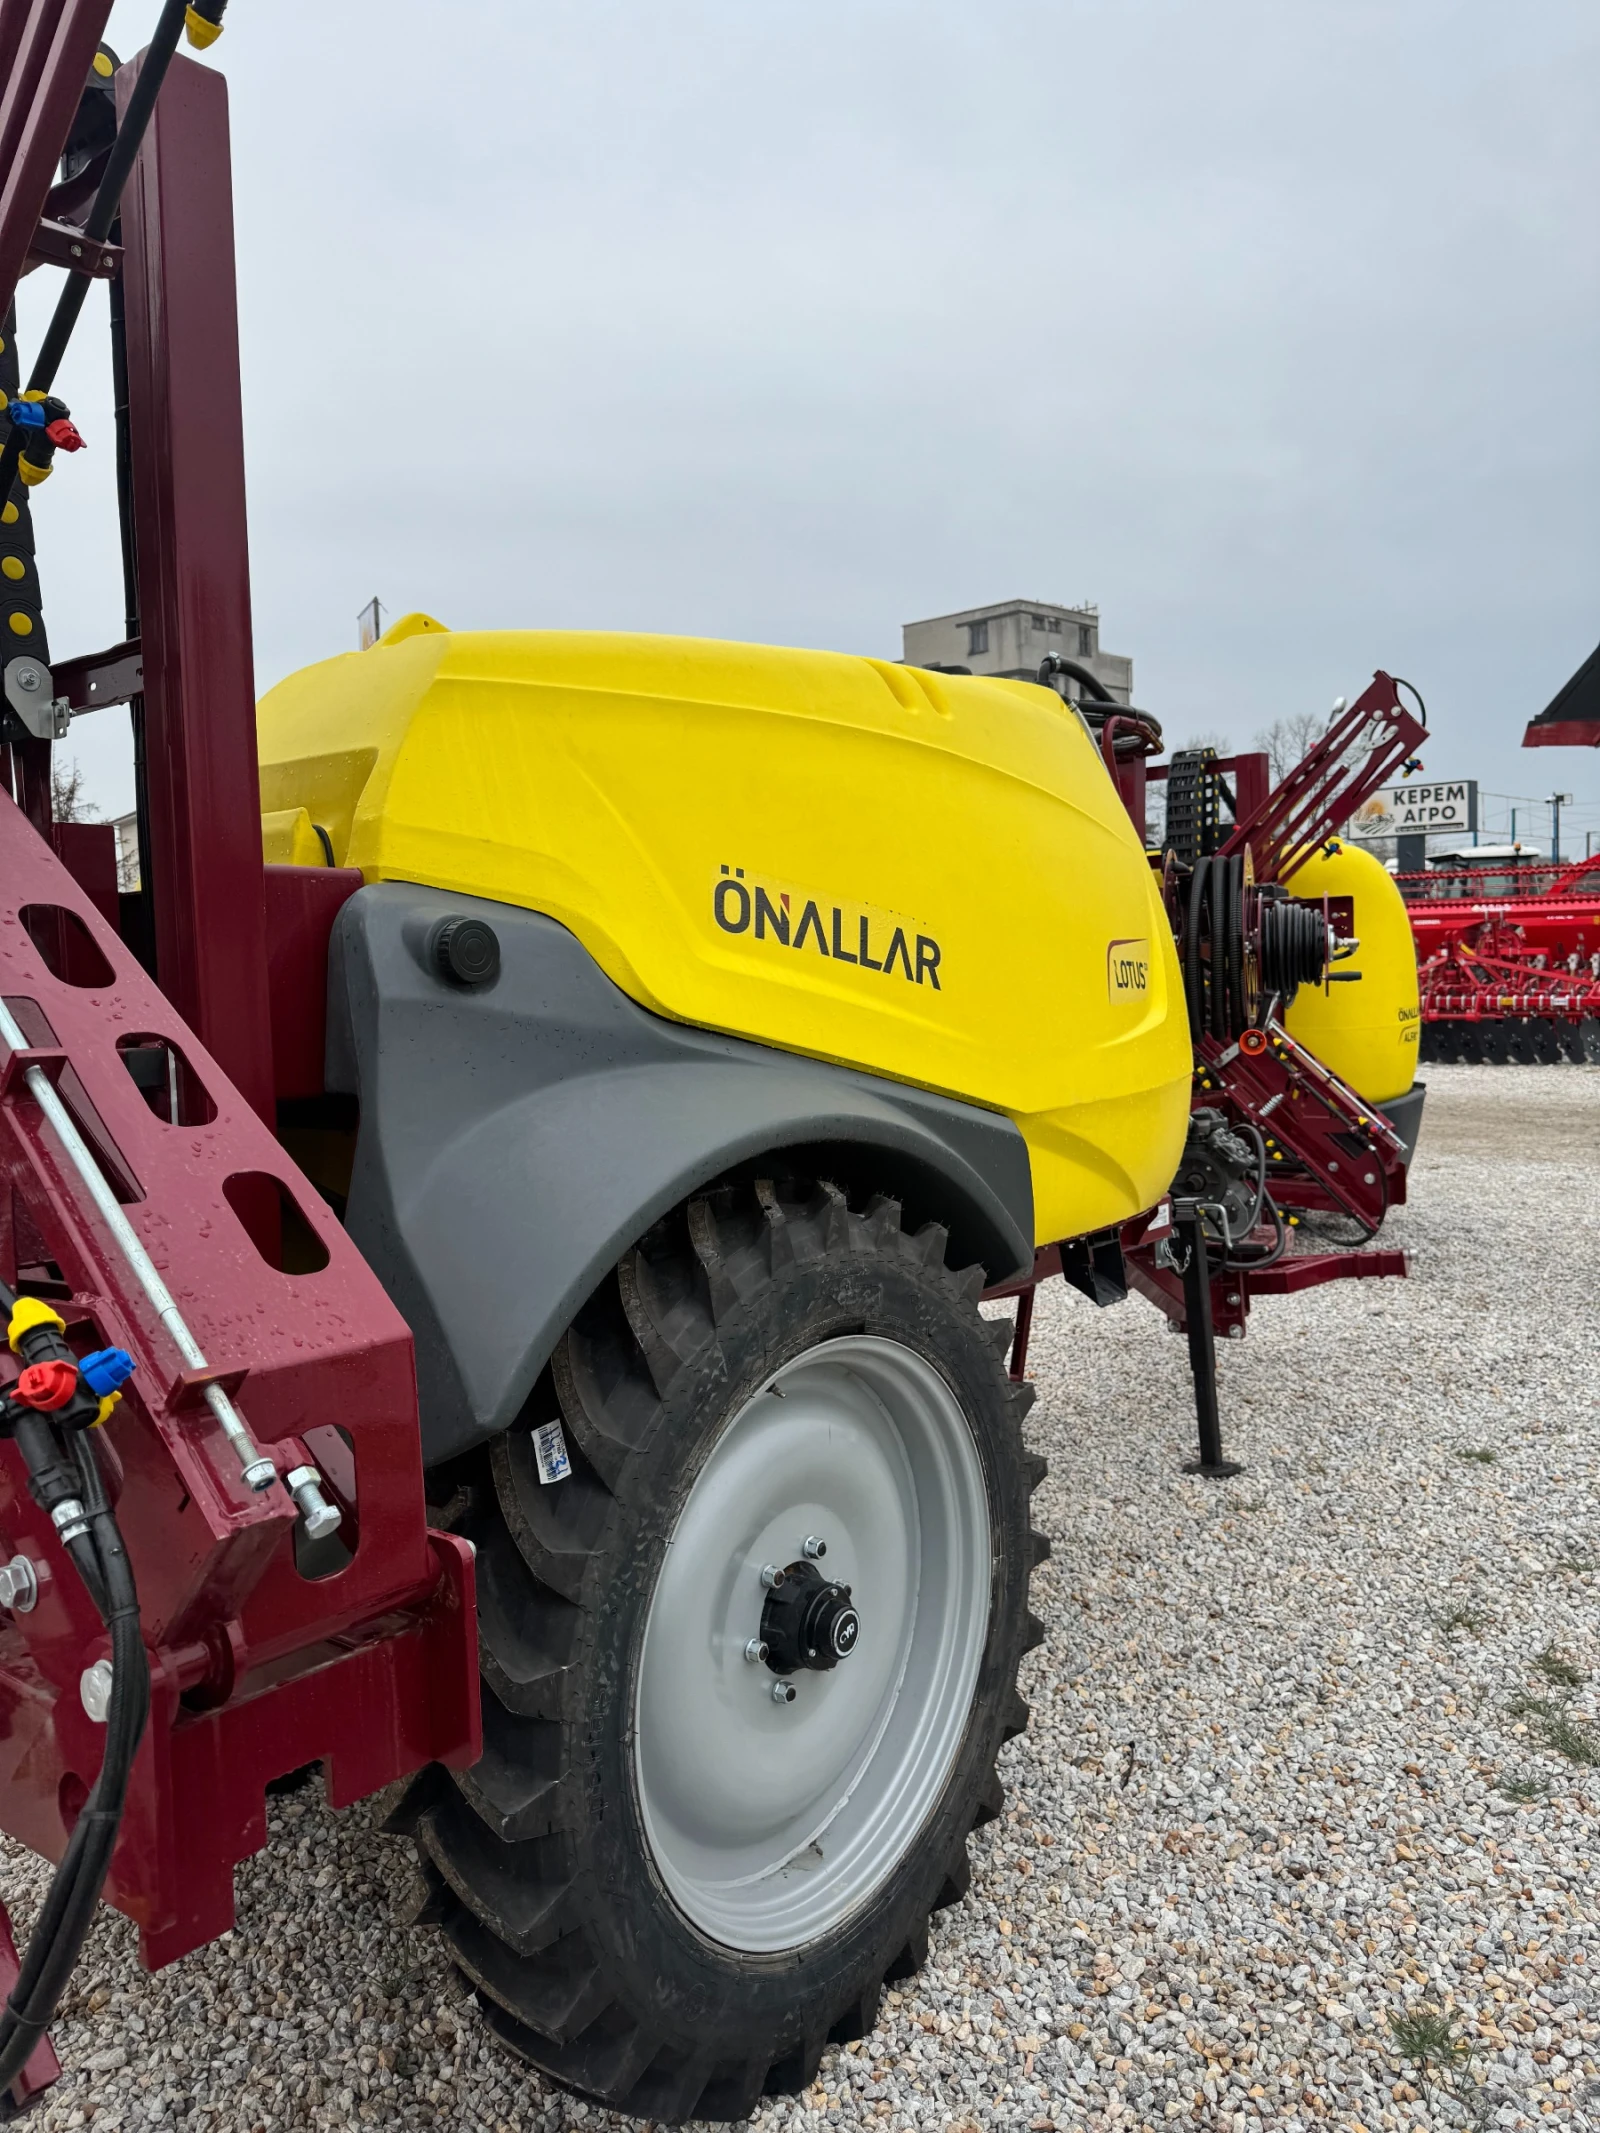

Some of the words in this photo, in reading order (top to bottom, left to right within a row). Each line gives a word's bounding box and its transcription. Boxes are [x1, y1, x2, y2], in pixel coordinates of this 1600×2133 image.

[1394, 785, 1465, 806] КЕРЕМ
[1404, 806, 1456, 823] АГРО
[714, 864, 941, 991] ÖNALLAR
[1113, 960, 1146, 990] LOTUS
